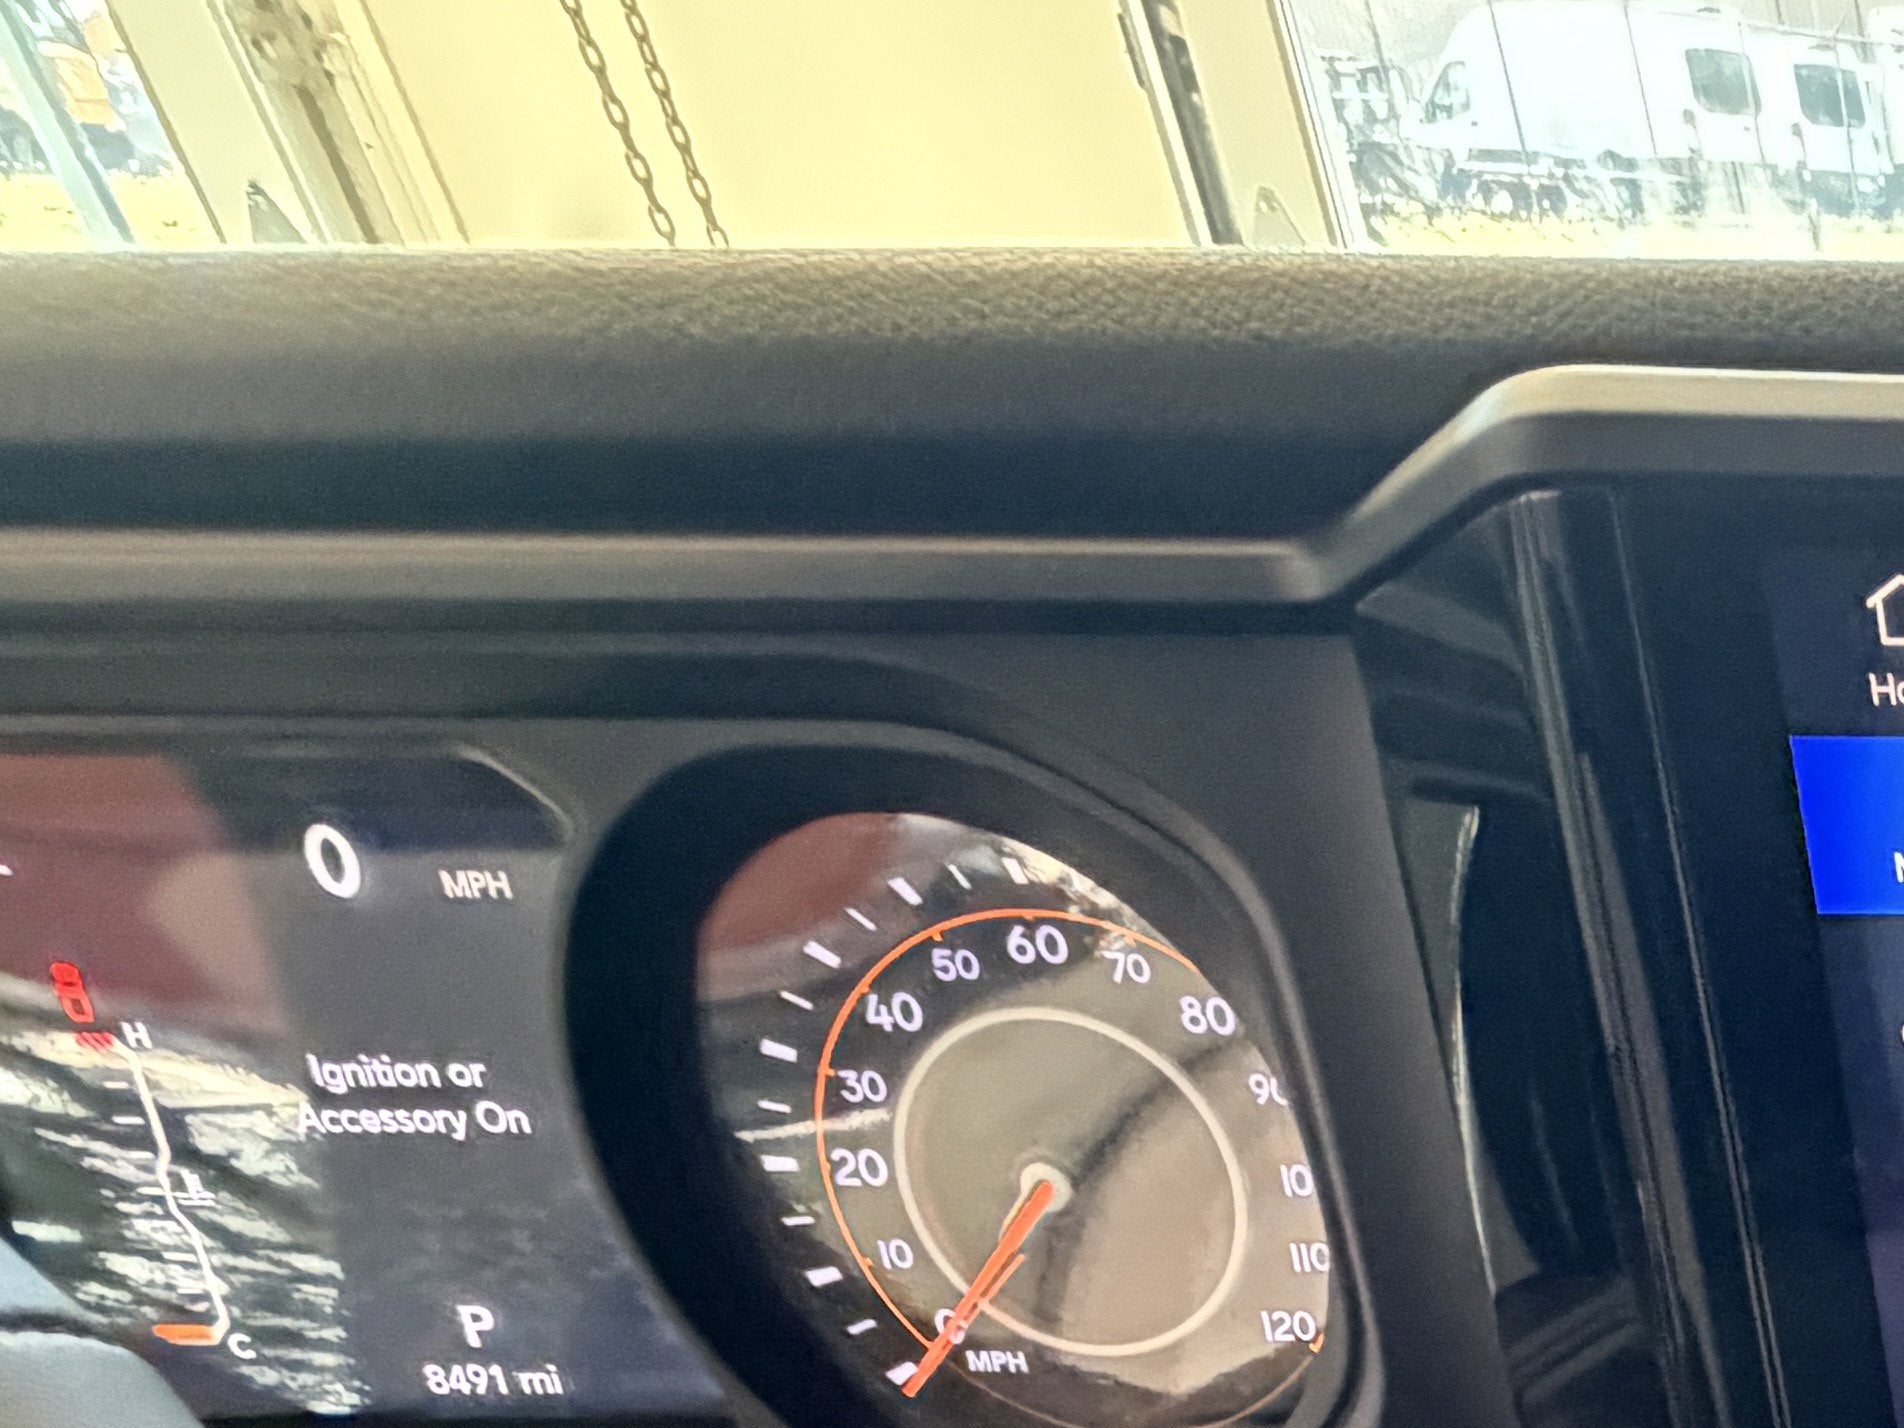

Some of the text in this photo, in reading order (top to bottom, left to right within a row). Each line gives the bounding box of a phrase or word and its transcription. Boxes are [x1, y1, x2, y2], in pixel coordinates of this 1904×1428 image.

[302, 823, 362, 899] 0
[439, 869, 512, 900] MPH
[1006, 925, 1069, 966] 60
[931, 948, 980, 982] 50
[1101, 950, 1151, 984] 70
[865, 992, 924, 1032] 40
[1179, 996, 1236, 1036] 80
[122, 1022, 152, 1050] H
[306, 1053, 486, 1094] Ignition or
[839, 1070, 888, 1103] 30
[298, 1100, 531, 1142] Accessory On
[830, 1148, 888, 1187] 20
[878, 1240, 913, 1269] 10
[1288, 1241, 1330, 1273] 110
[457, 1305, 495, 1347] P
[1259, 1310, 1316, 1341] 120
[229, 1333, 256, 1360] C
[966, 1350, 1030, 1374] MPH
[424, 1364, 563, 1395] 8491 mi
